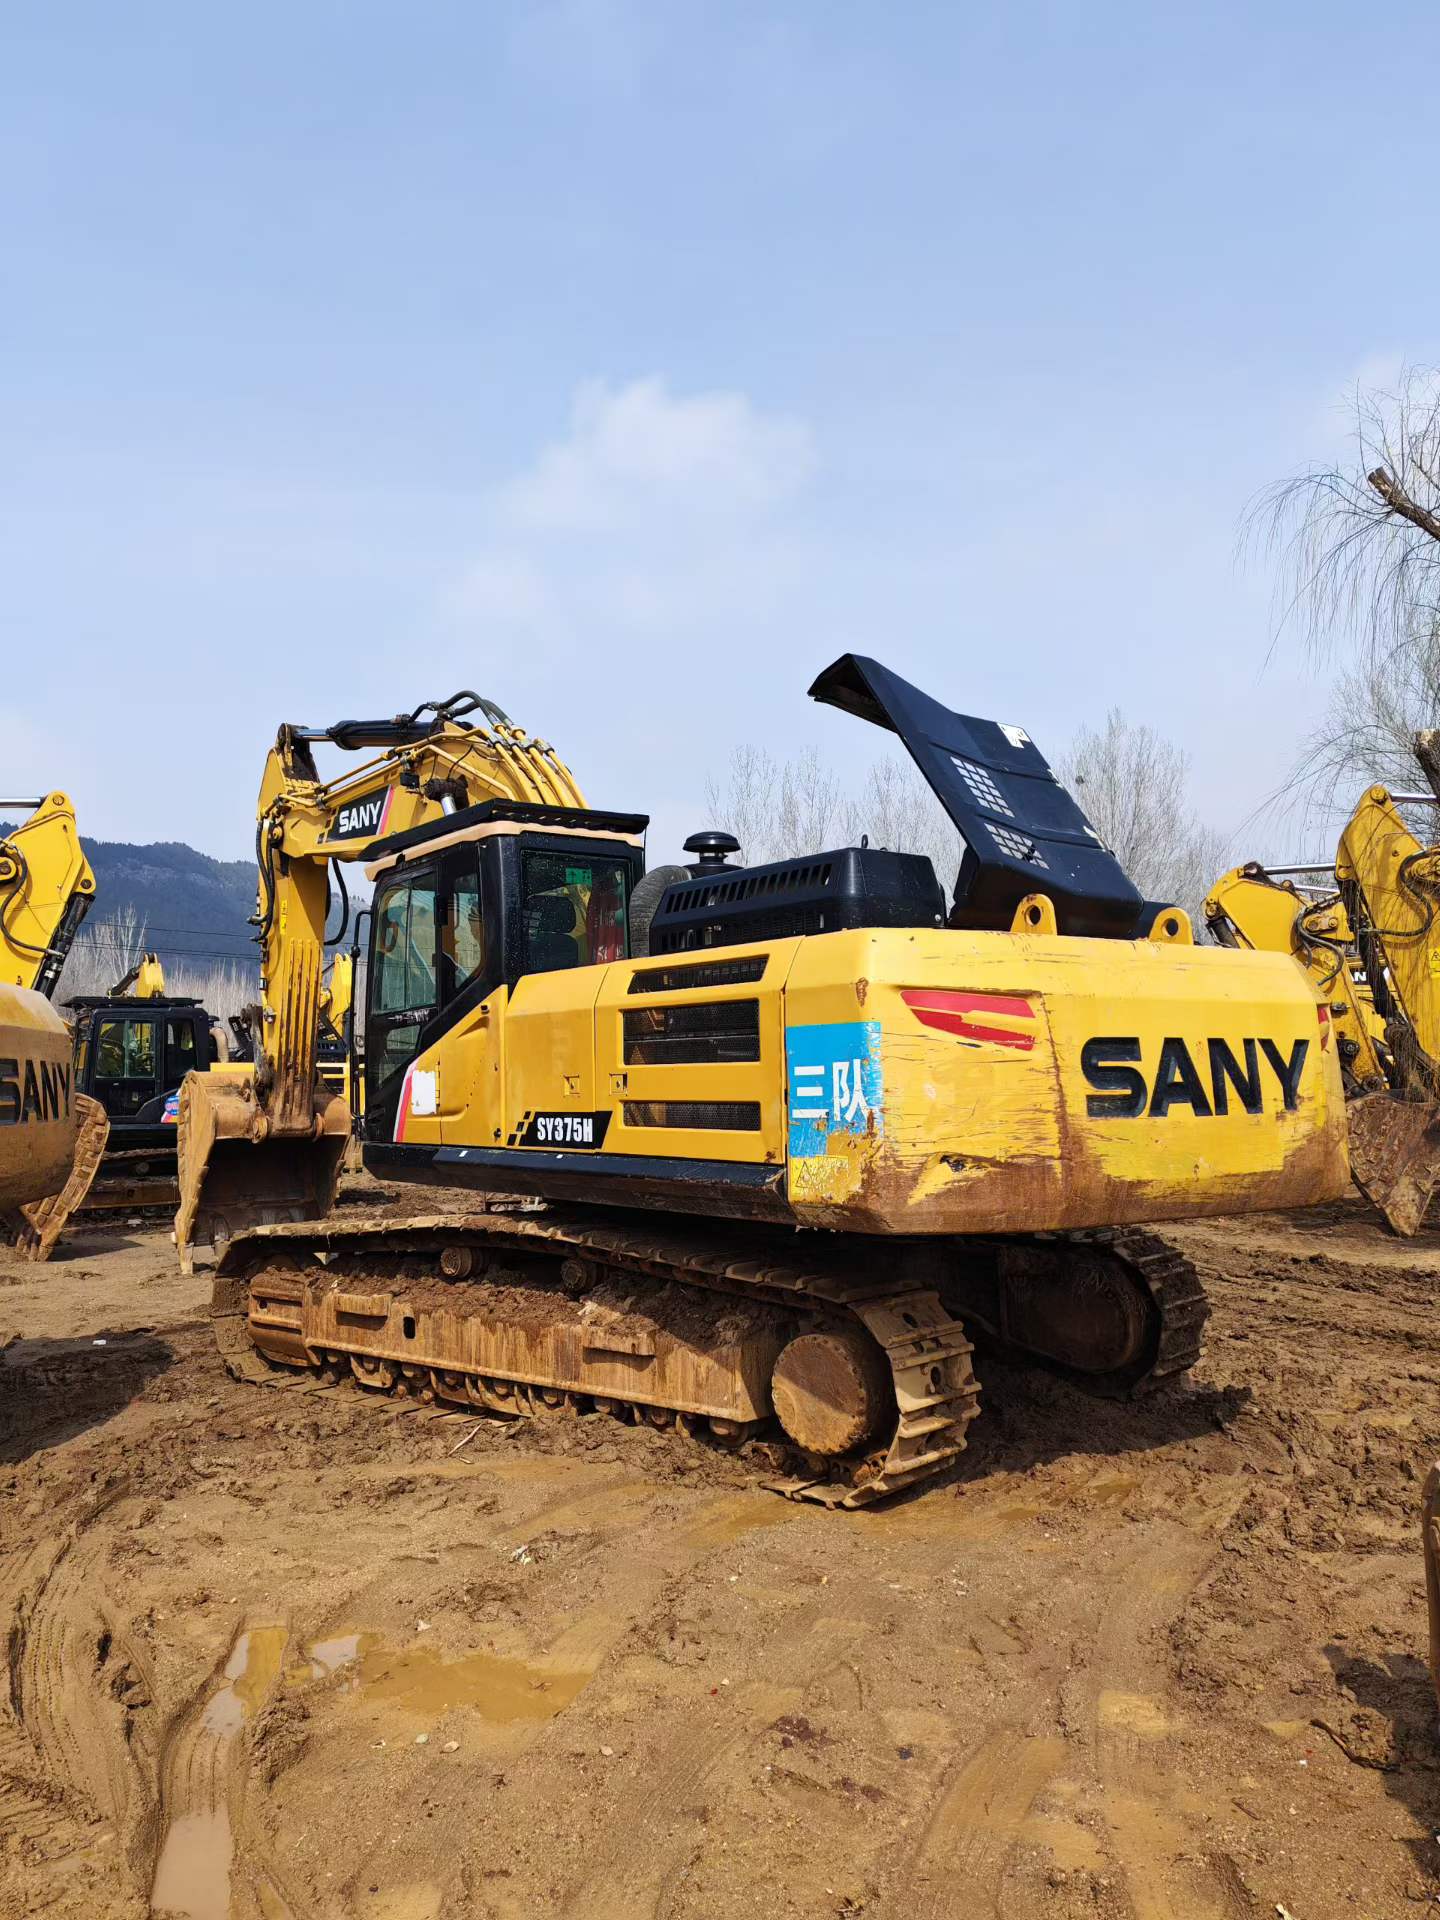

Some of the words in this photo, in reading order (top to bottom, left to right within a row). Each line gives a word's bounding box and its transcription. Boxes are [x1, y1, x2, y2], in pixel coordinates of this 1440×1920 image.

[339, 801, 381, 833] SANY
[792, 1059, 873, 1123] 三队
[1081, 1037, 1310, 1118] SANY
[537, 1117, 593, 1143] SY375H
